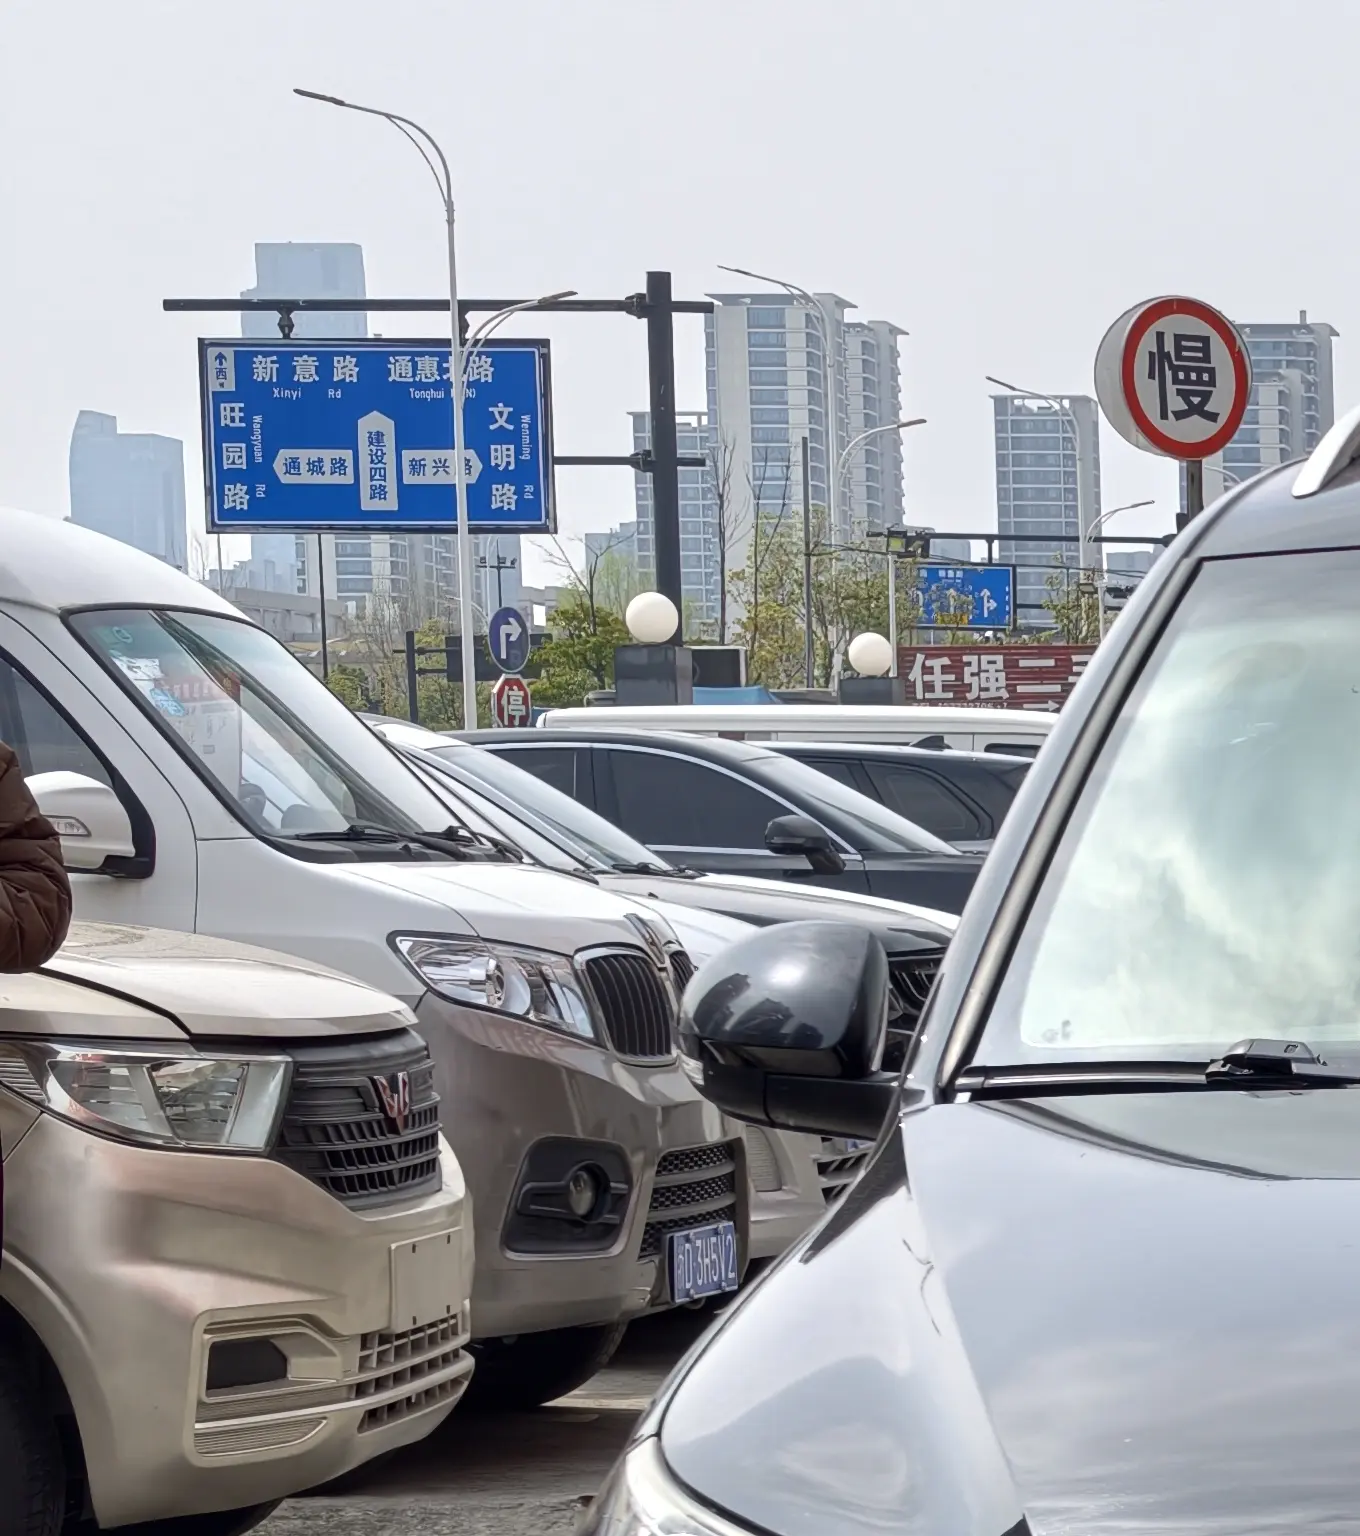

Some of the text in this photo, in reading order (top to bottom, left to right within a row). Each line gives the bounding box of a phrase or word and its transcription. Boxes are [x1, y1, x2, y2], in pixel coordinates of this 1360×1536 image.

[215, 367, 228, 381] 西
[252, 355, 360, 383] 新意路
[273, 387, 342, 400] Xinyi Rd
[409, 387, 444, 401] Tonghui
[1148, 331, 1220, 424] 慢
[220, 403, 250, 511] 旺园路
[251, 414, 266, 498] Wangyuan Rd
[283, 456, 348, 477] 通城路
[367, 430, 388, 501] 建设四路
[488, 403, 518, 511] 文明路
[520, 414, 534, 499] Wenming Rd
[501, 685, 526, 726] 停
